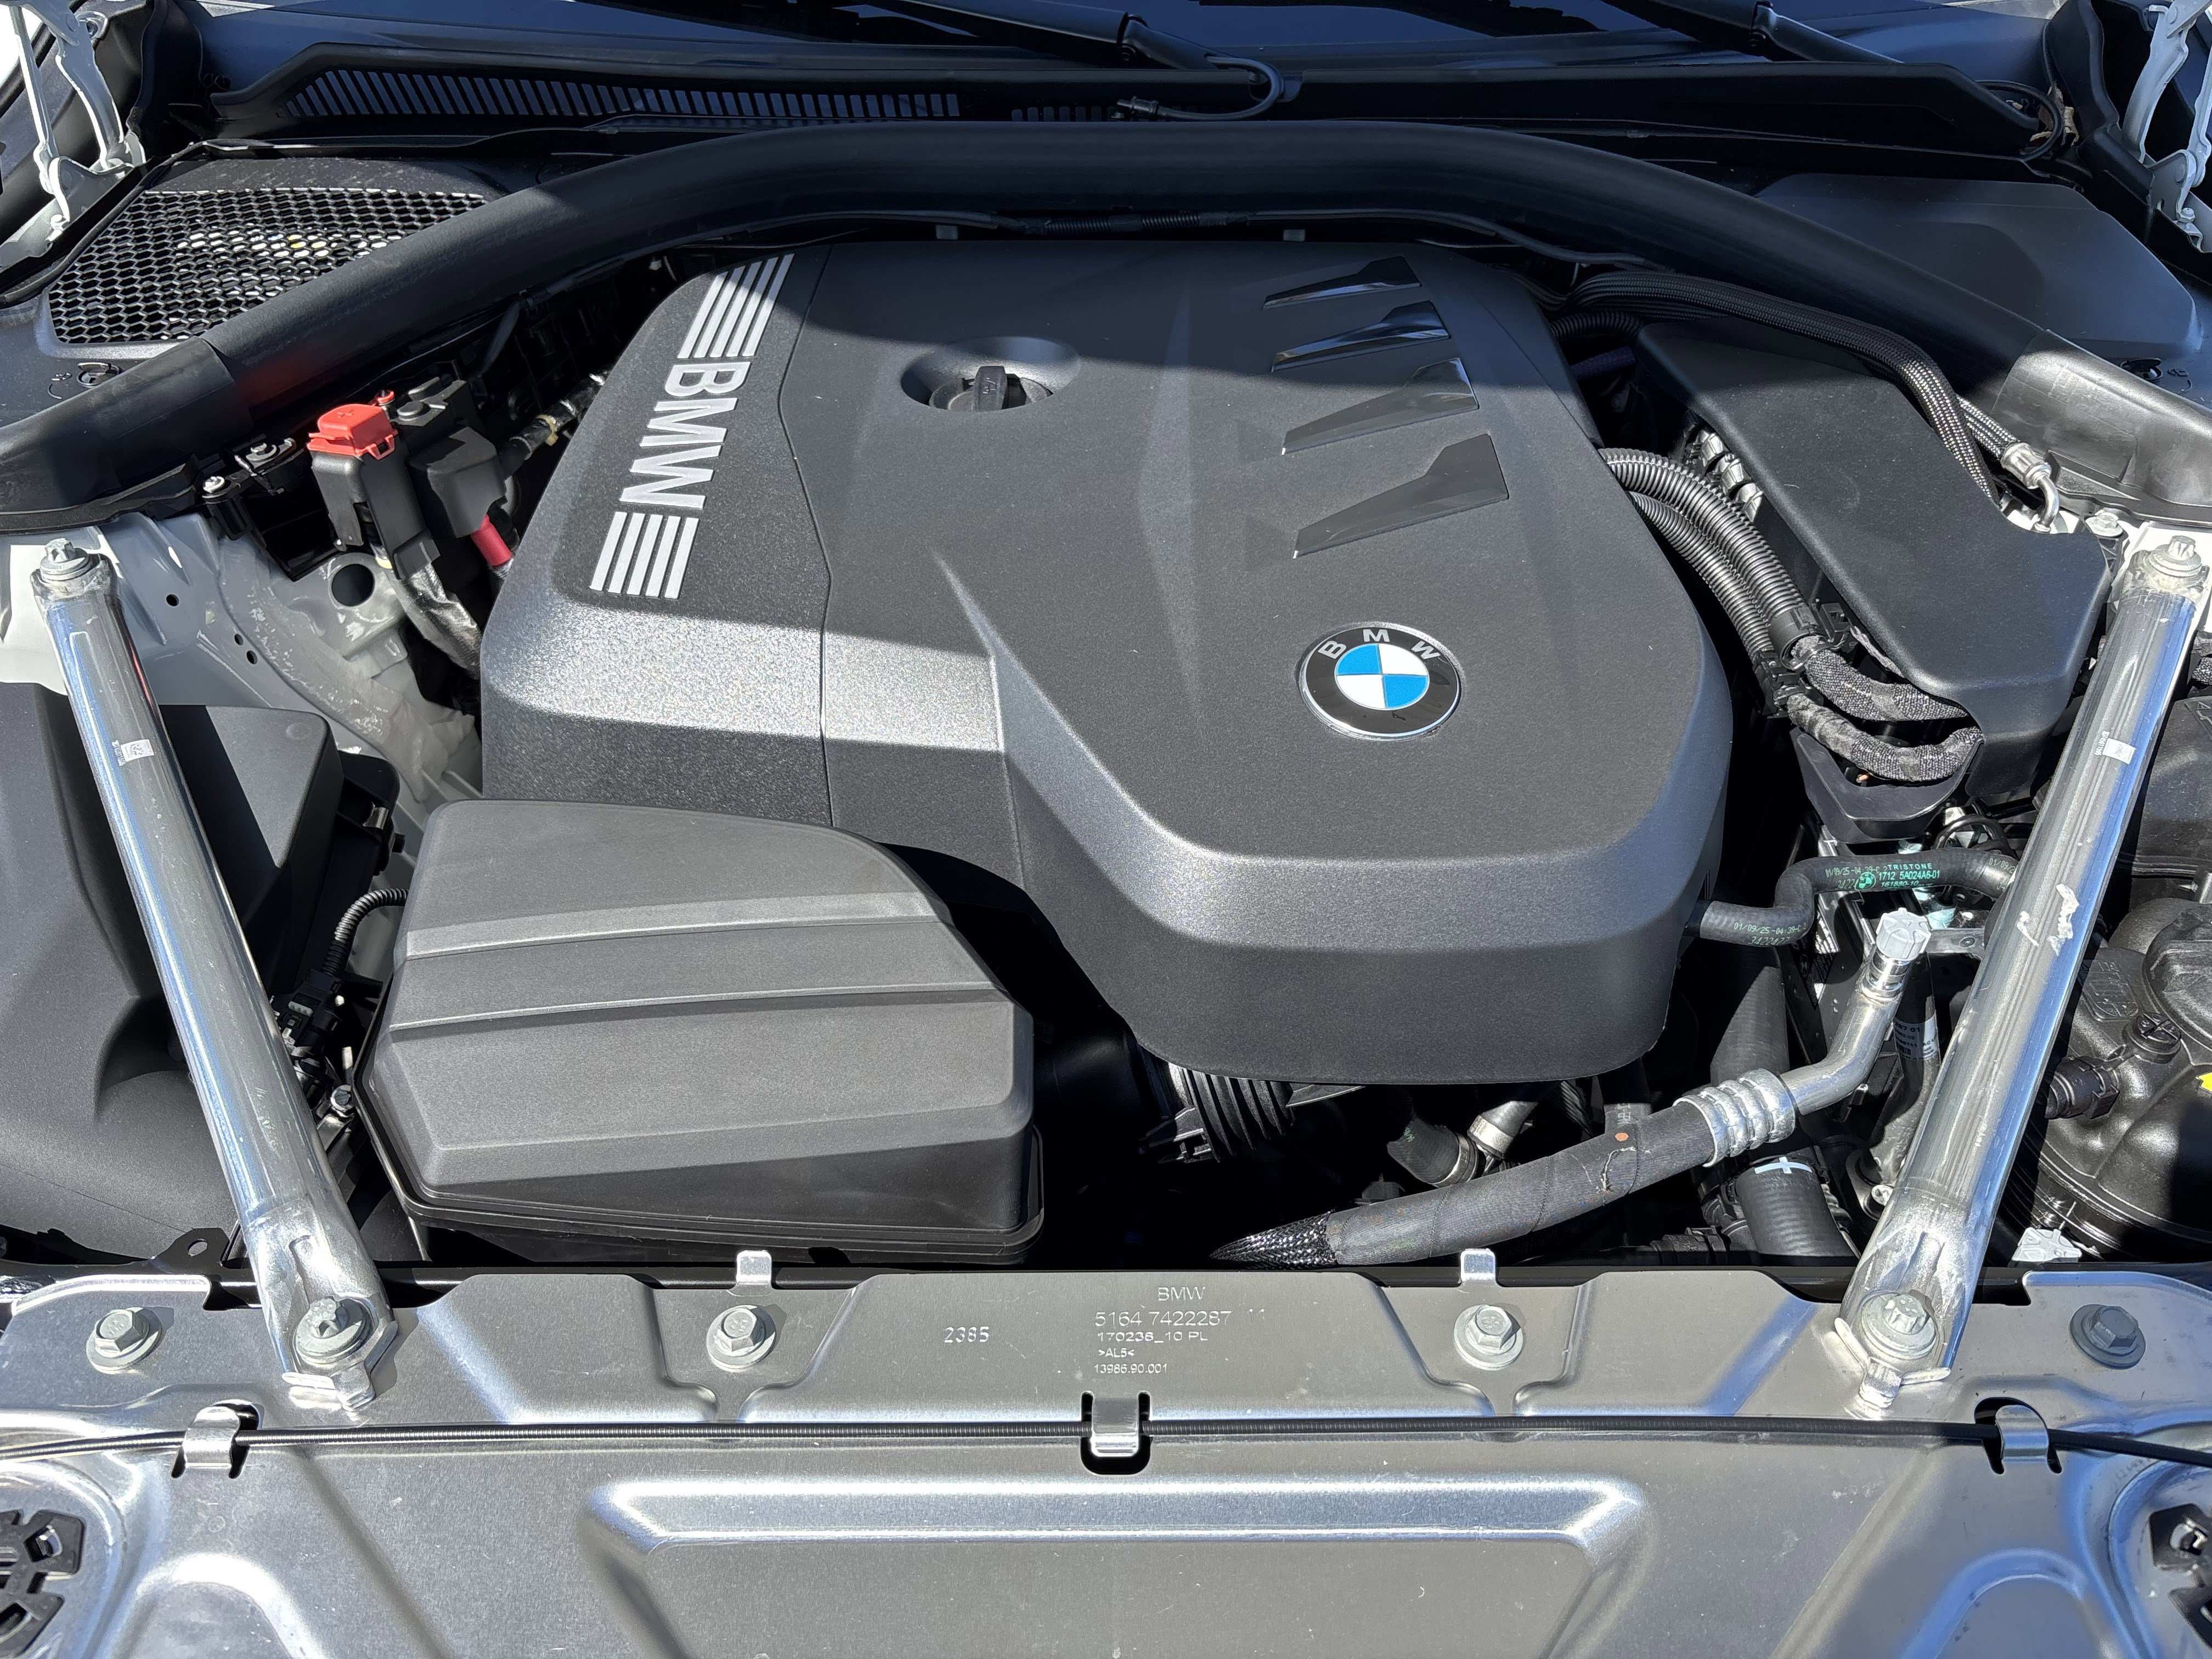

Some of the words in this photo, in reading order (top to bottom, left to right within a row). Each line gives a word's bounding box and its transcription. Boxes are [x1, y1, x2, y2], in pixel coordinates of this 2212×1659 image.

[619, 362, 751, 510] BMW
[1317, 628, 1441, 660] BMW
[1989, 857, 2016, 874] 01/09/2
[1878, 871, 1895, 881] 1712
[1158, 1286, 1205, 1301] BMW
[1095, 1312, 1142, 1327] 5164
[1149, 1311, 1232, 1326] 7422287
[944, 1326, 989, 1343] 2385
[1097, 1331, 1183, 1344] 170238_10
[1188, 1331, 1208, 1341] PL
[1094, 1363, 1167, 1374] 13986.90.001
